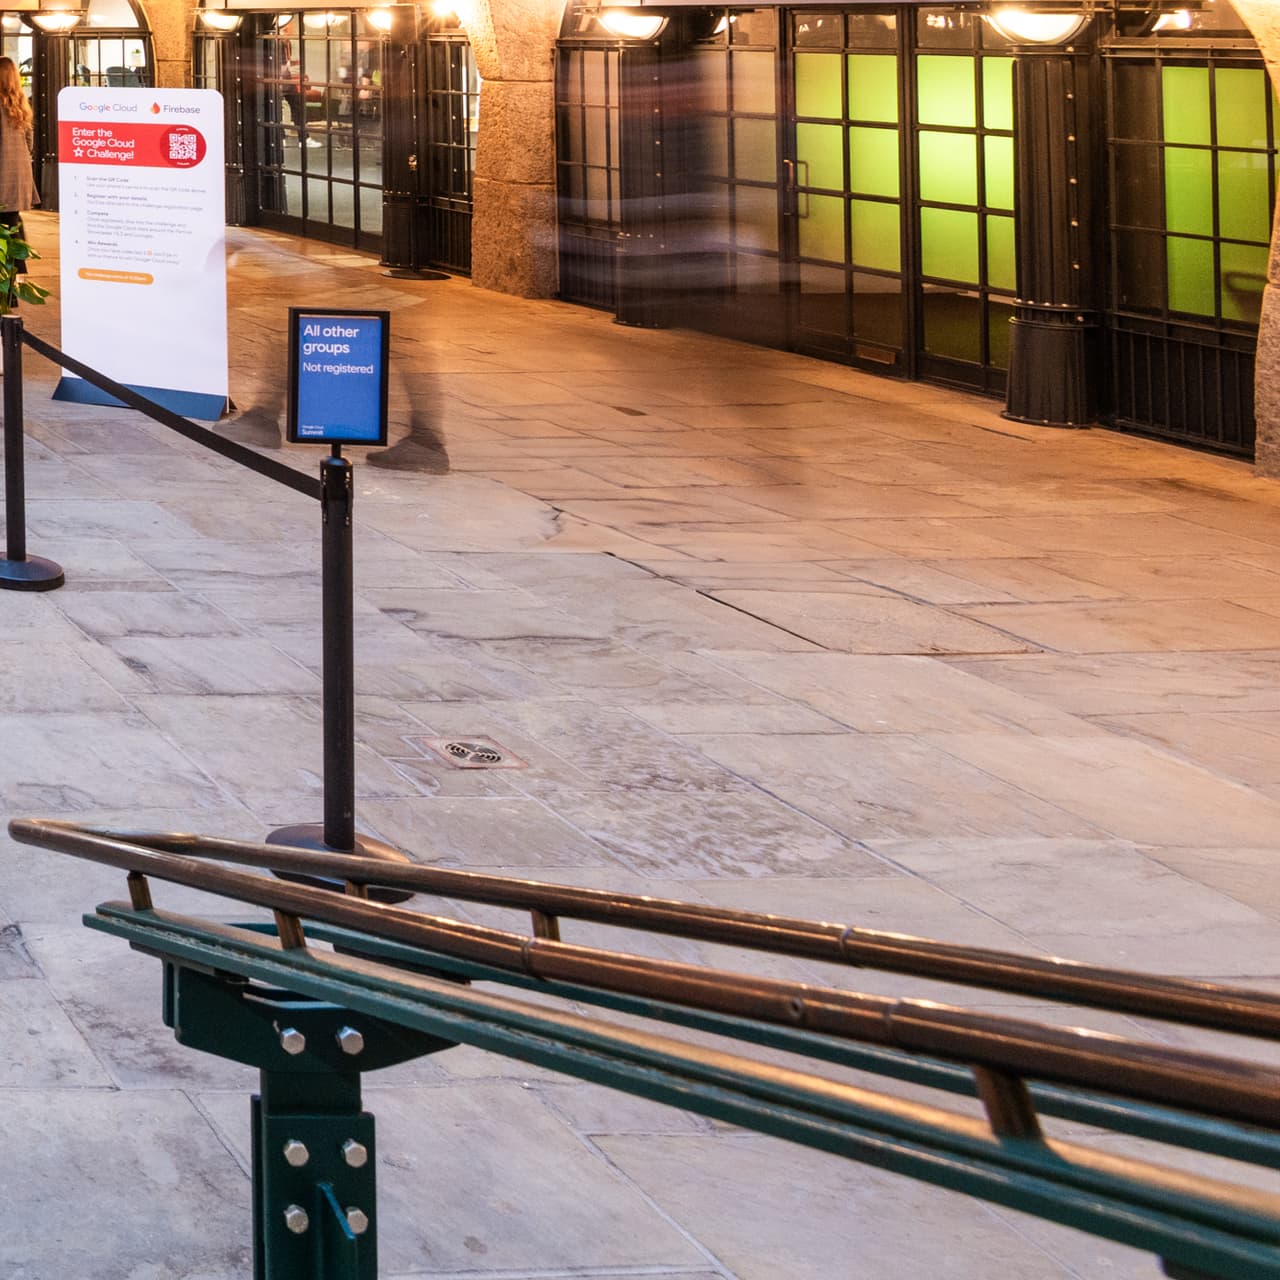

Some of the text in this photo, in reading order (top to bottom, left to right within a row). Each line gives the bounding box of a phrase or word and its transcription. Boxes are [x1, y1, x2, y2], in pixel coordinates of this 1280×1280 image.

[79, 102, 138, 113] Google Cloud
[163, 104, 201, 114] Firebase
[72, 127, 112, 137] Enter the
[72, 137, 135, 148] Google Cloud
[86, 148, 135, 161] Challenge!
[303, 324, 360, 338] All other
[303, 342, 351, 356] groups
[303, 362, 374, 376] Not registered
